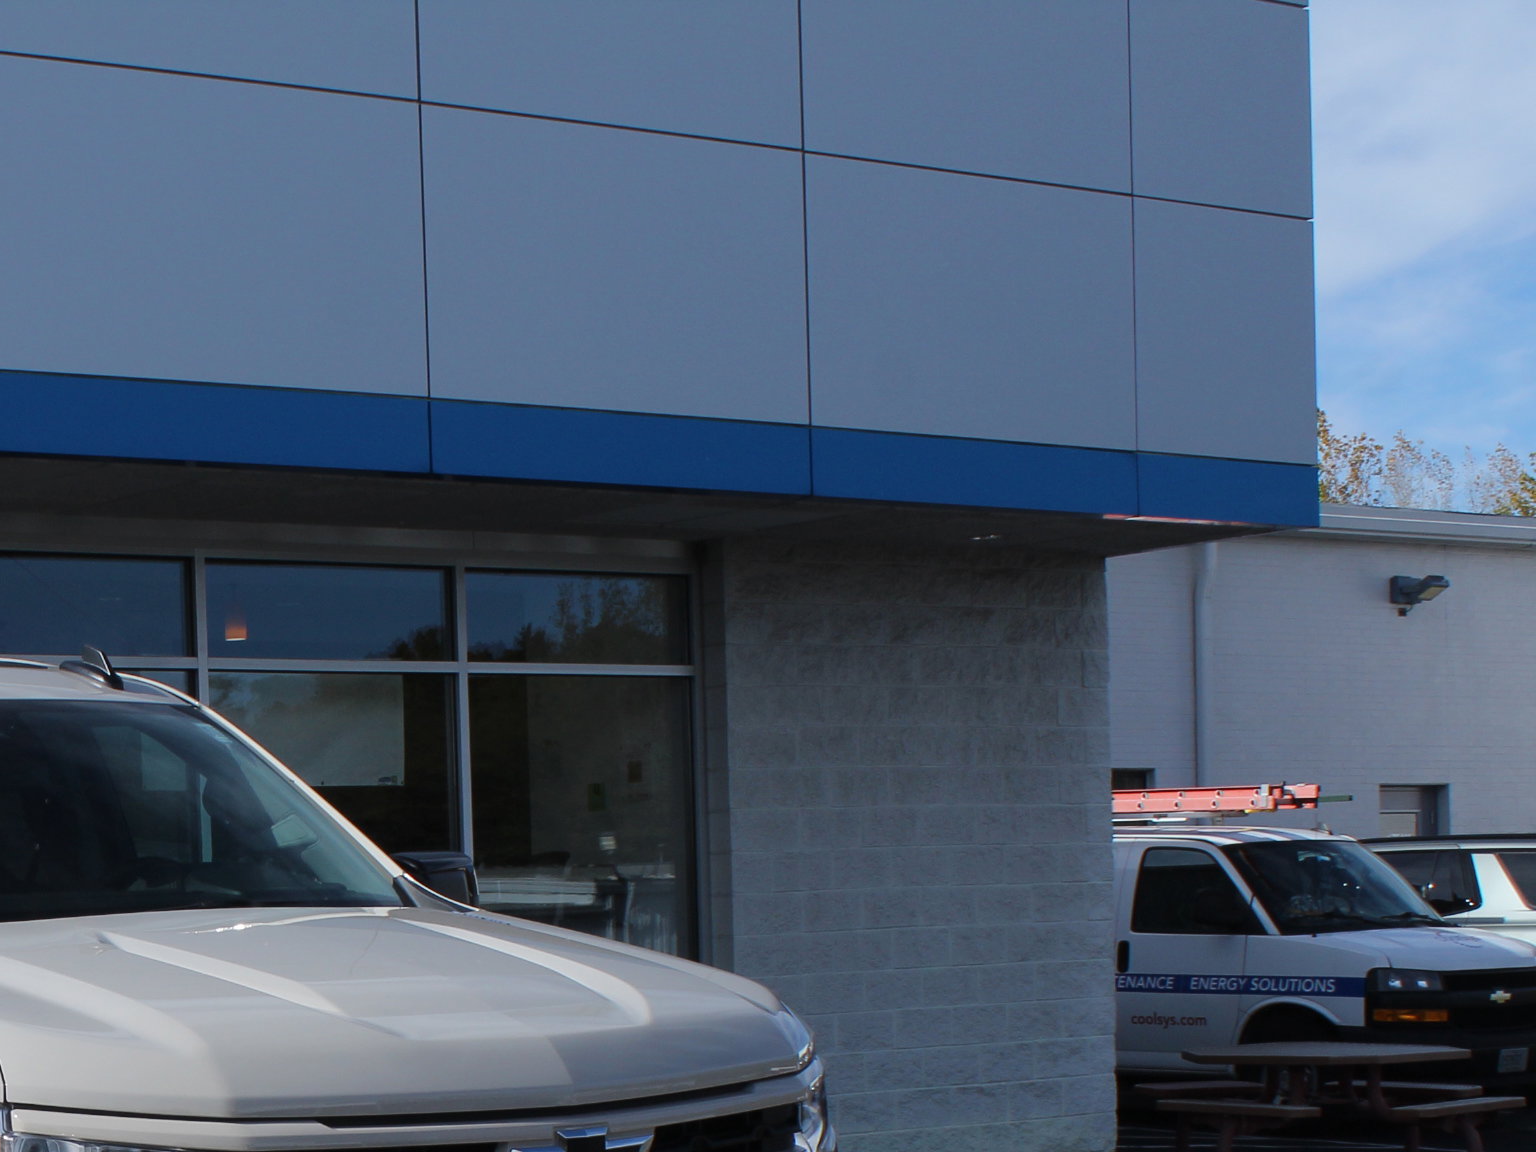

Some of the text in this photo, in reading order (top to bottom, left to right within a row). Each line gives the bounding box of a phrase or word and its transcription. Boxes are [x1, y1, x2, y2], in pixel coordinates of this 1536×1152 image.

[1190, 976, 1248, 991] ENERGY
[1250, 977, 1337, 993] SOLUTIONS
[1130, 1012, 1208, 1029] coolsys.com
